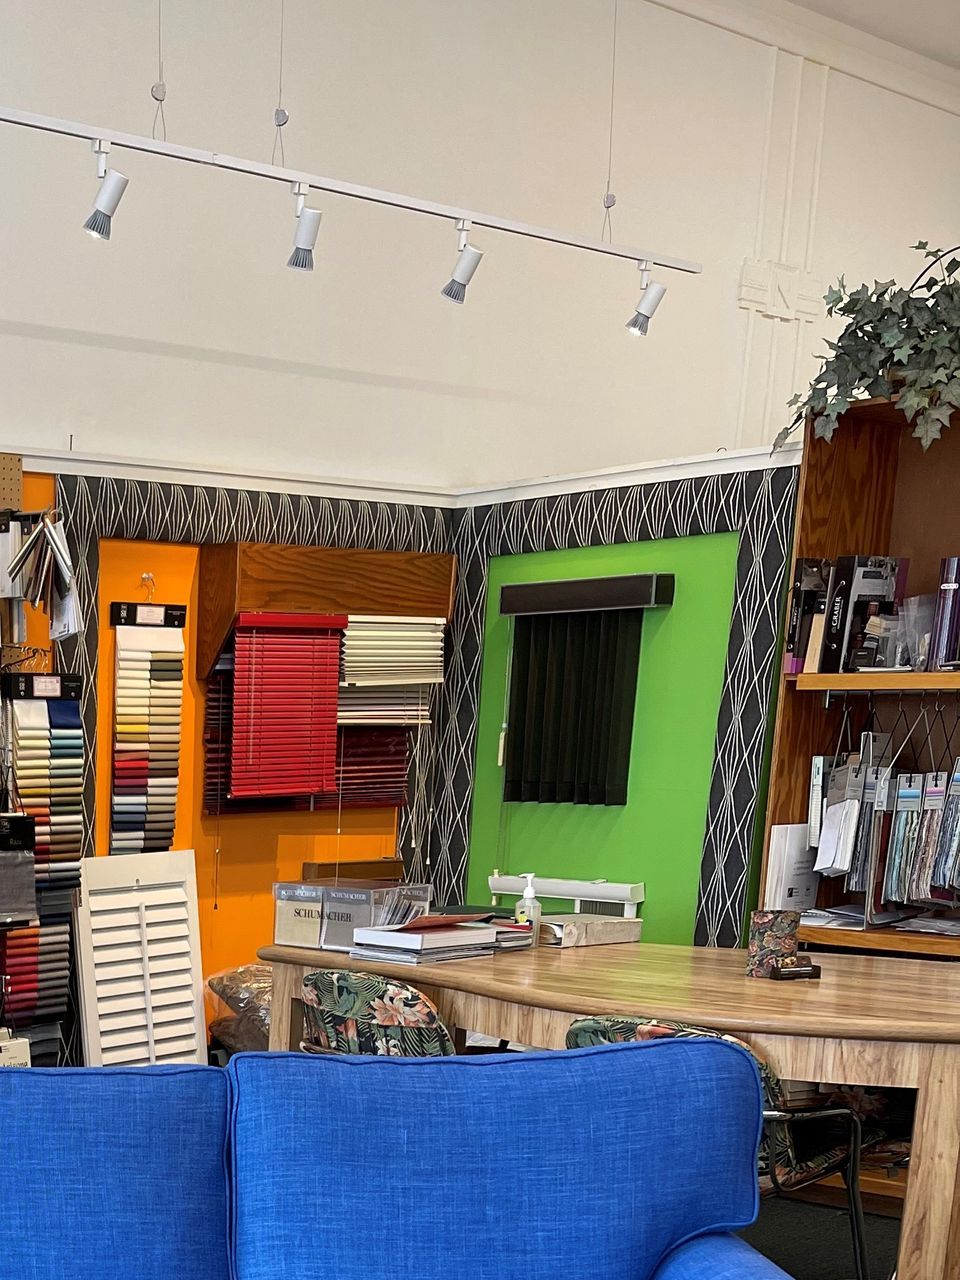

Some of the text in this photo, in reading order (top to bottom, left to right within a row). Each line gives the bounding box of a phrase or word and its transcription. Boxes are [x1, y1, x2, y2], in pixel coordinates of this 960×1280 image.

[831, 596, 842, 627] GRABER
[330, 892, 367, 900] SCHUMACHER
[293, 907, 352, 922] SCHUMACHER
